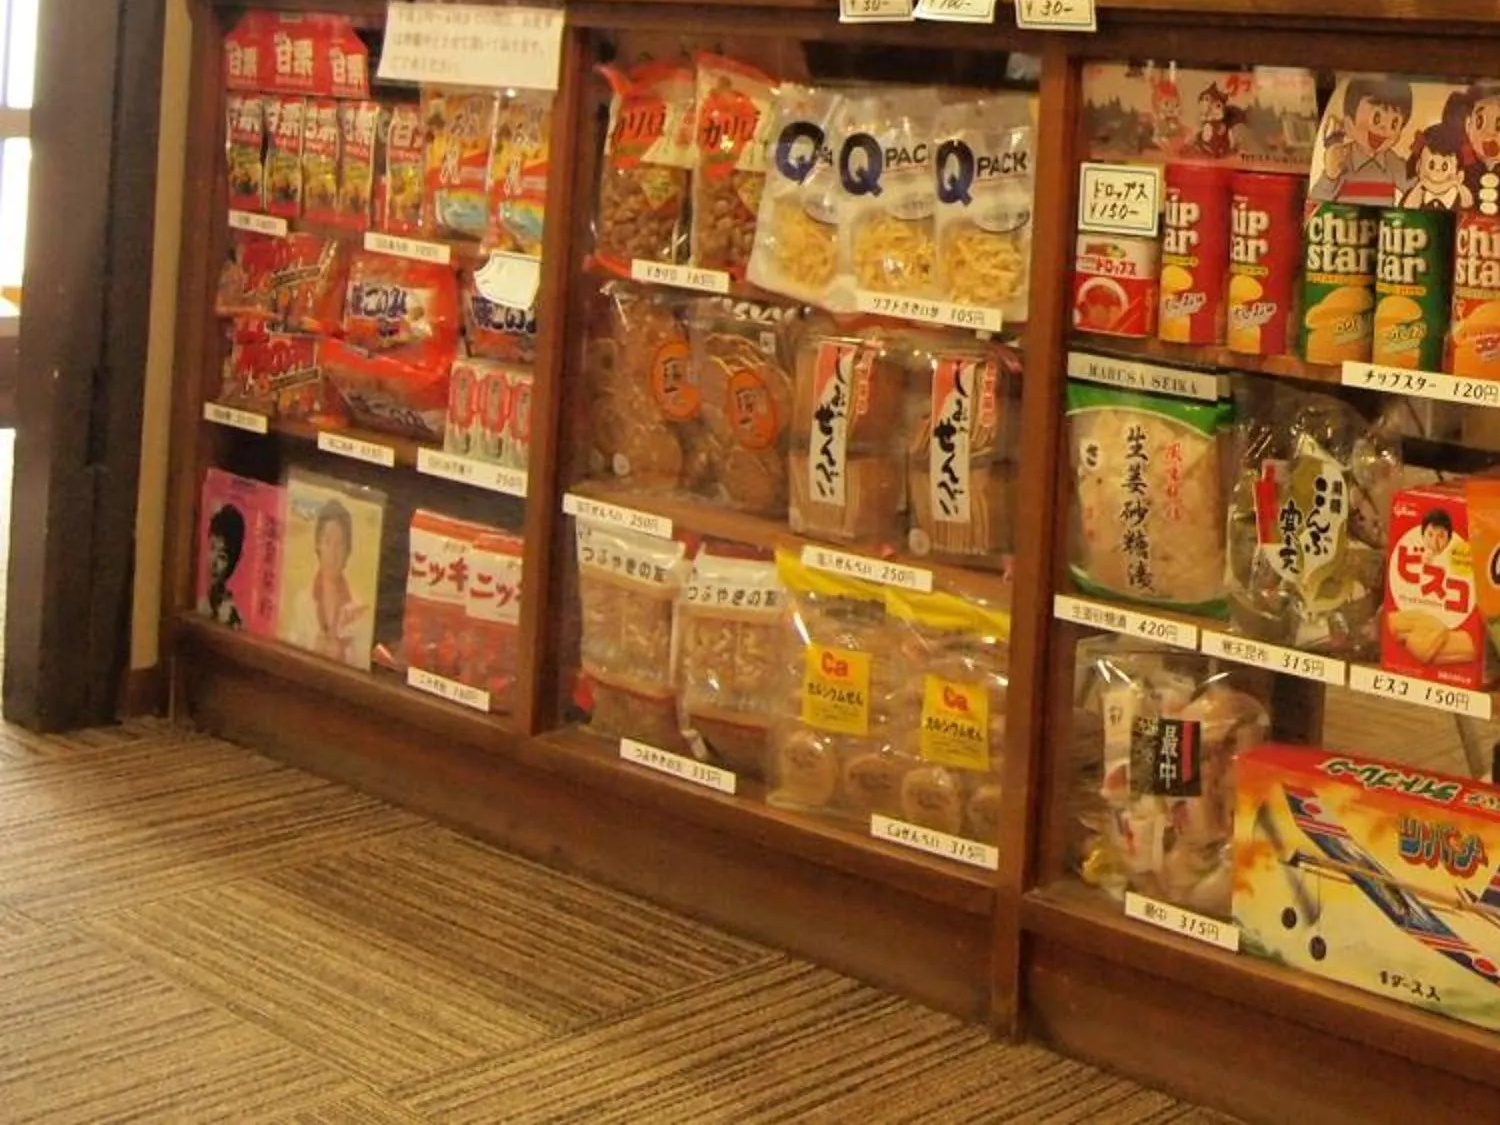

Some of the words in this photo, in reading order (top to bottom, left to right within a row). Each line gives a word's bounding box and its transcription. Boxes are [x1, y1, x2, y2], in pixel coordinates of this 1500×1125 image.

[776, 120, 825, 184] Q
[839, 131, 884, 197] Q
[884, 143, 930, 166] PAC
[935, 138, 974, 207] Q
[976, 149, 1029, 175] PACK
[1093, 178, 1149, 203] ドロップス
[1165, 194, 1199, 228] ip
[1232, 202, 1269, 236] ip
[1308, 206, 1377, 248] chip
[1163, 228, 1199, 255] ar
[1231, 237, 1269, 264] ar
[1377, 217, 1428, 255] hip
[1307, 241, 1376, 276] star
[1376, 250, 1426, 285] tar
[950, 307, 986, 325] 105円
[1361, 367, 1437, 391] チップスター
[1452, 380, 1498, 402] 120円
[1119, 425, 1156, 592] 生姜砂糖漬
[411, 551, 469, 593] ニッキ
[880, 564, 917, 584] 250円
[1396, 545, 1470, 614] ビスコ
[470, 571, 522, 608] ニッ
[1137, 621, 1178, 641] 420円
[820, 651, 849, 677] Ca
[1281, 652, 1326, 675] 315円
[943, 687, 970, 713] Ca
[1373, 676, 1409, 695] ビスコ
[1424, 688, 1470, 709] 150円
[1159, 726, 1179, 790] 最中
[1180, 914, 1219, 940] 315円
